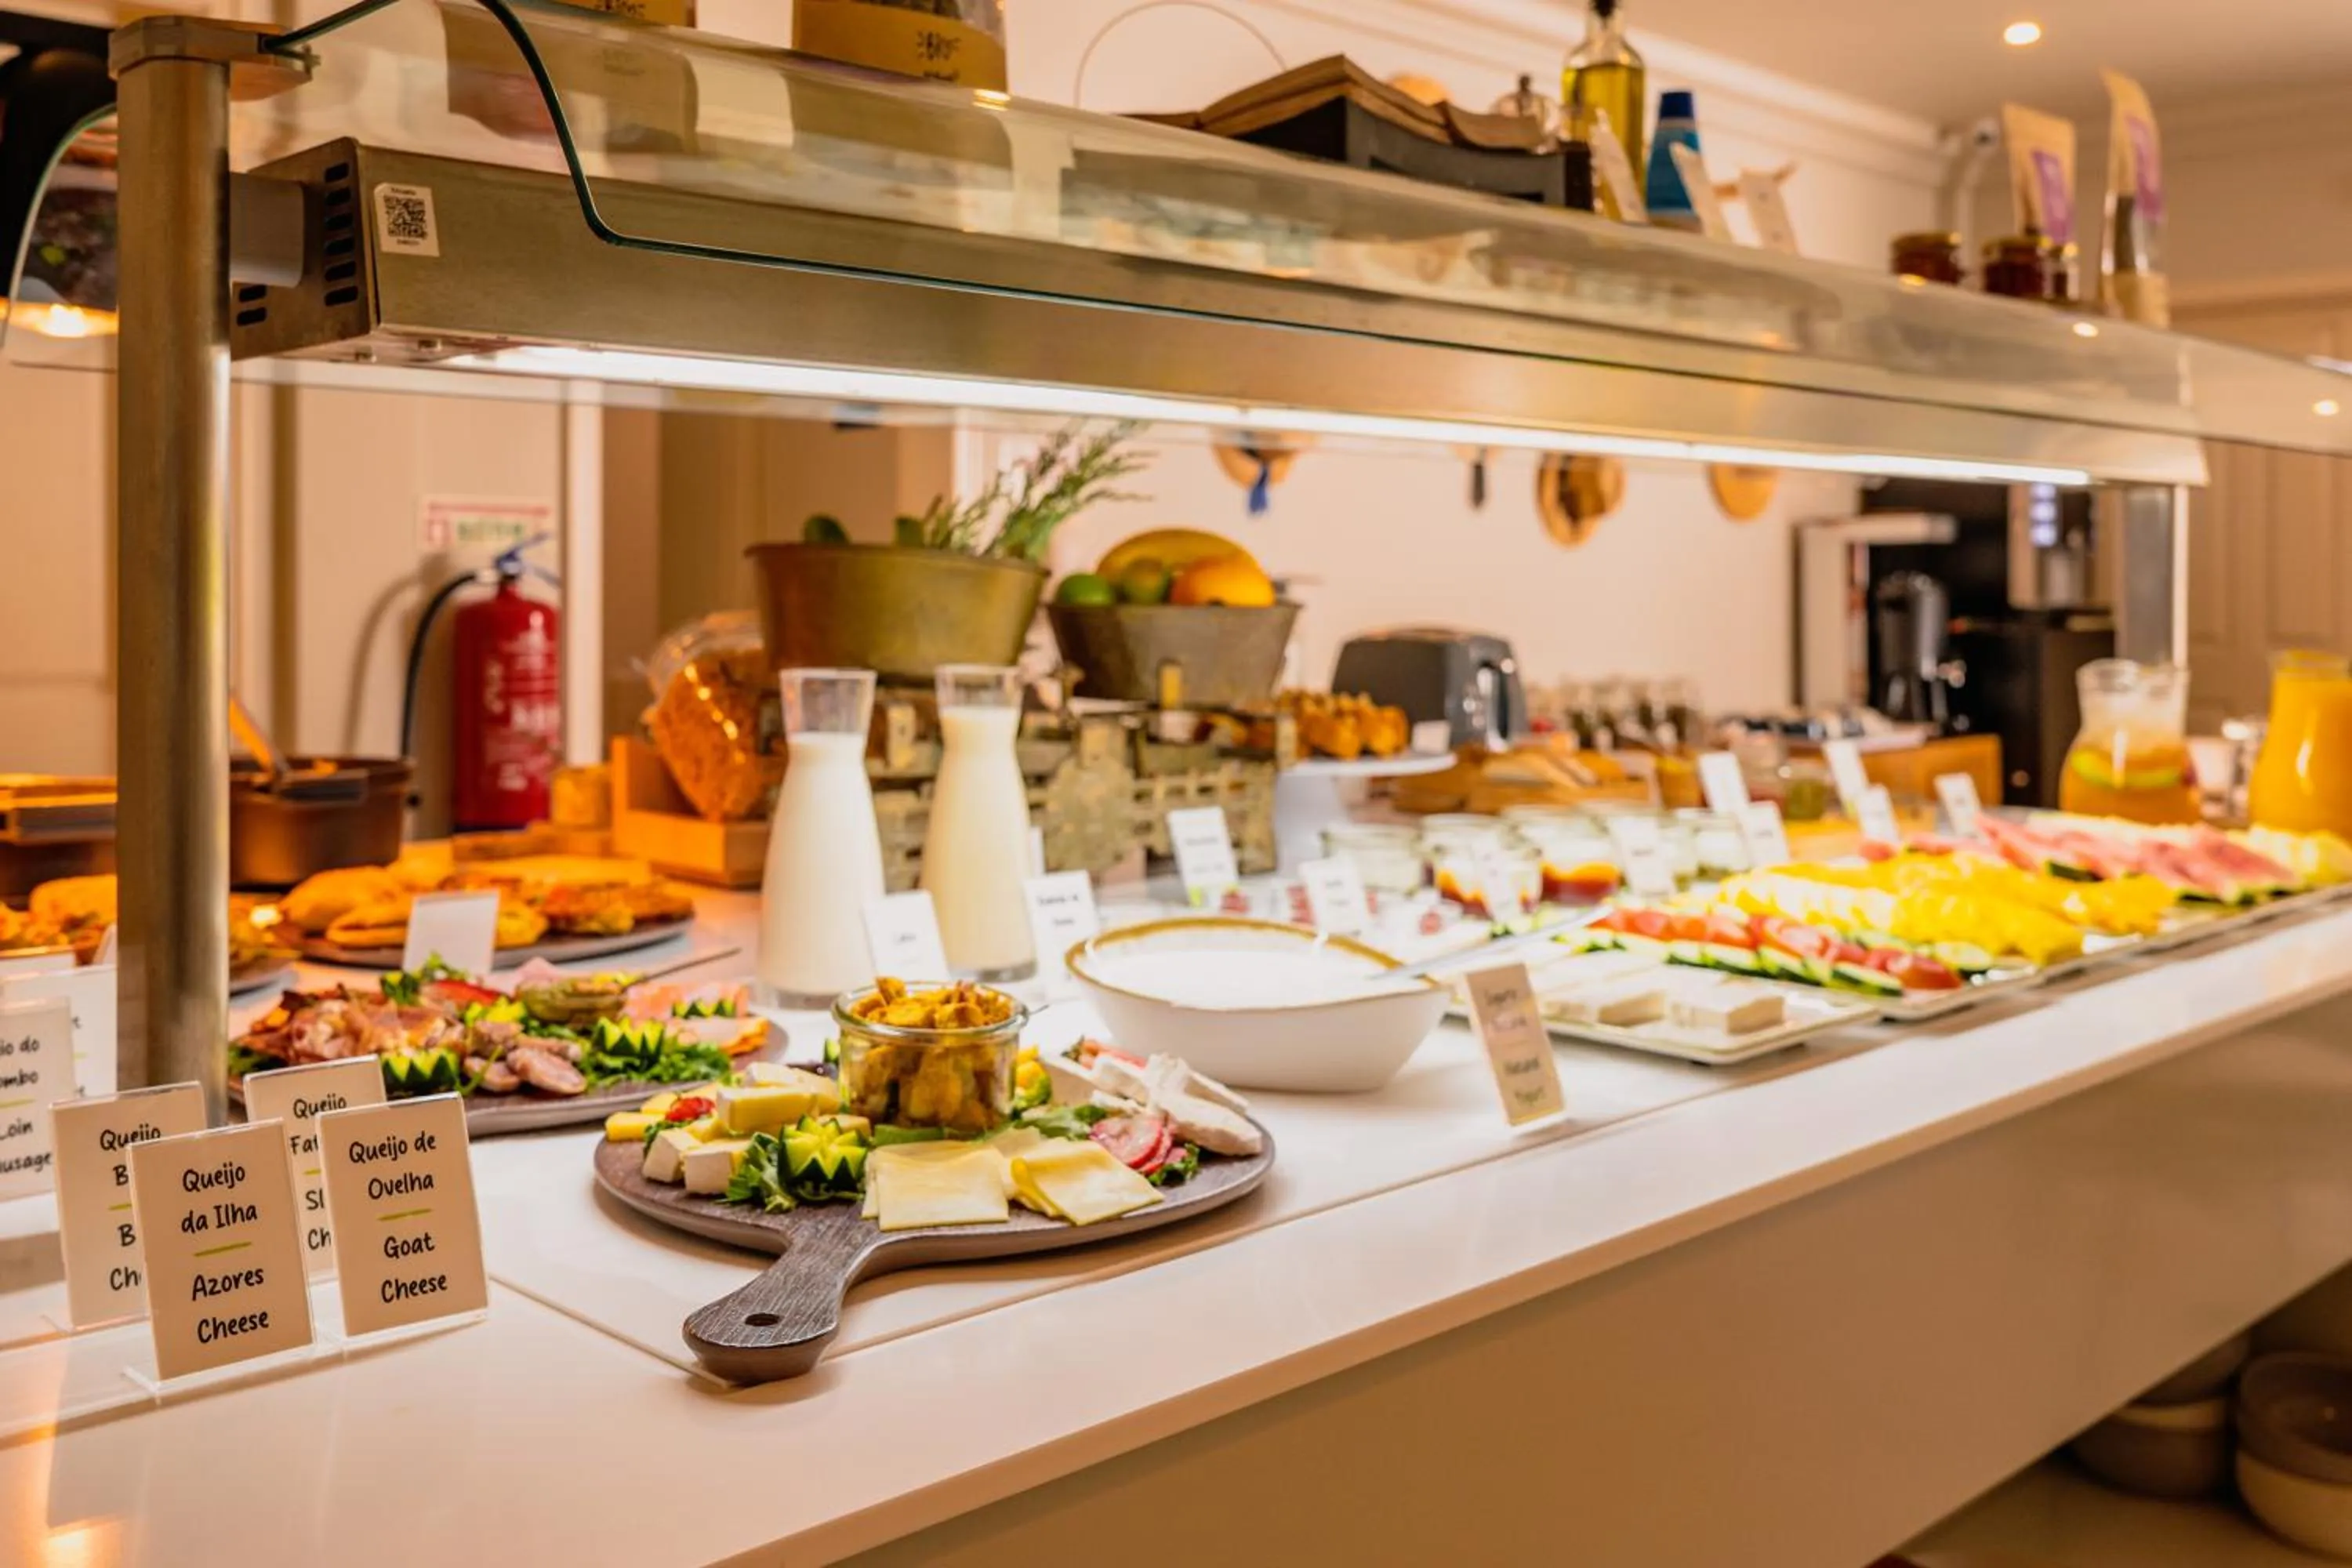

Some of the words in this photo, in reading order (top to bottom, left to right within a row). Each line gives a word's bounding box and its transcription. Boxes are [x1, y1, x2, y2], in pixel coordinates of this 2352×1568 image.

[19, 1036, 40, 1053] do
[0, 1069, 38, 1088] ombo
[0, 1118, 33, 1141] oin
[349, 1135, 408, 1164] Queijo
[414, 1130, 437, 1153] de
[0, 1153, 52, 1174] usage
[182, 1161, 246, 1192] Queijo
[368, 1172, 434, 1200] Ovelha
[181, 1210, 209, 1234] da
[212, 1203, 258, 1229] Ilha
[383, 1232, 435, 1259] Goat
[192, 1268, 265, 1301] Azores
[380, 1274, 448, 1304] Cheese
[197, 1311, 270, 1345] Cheese
